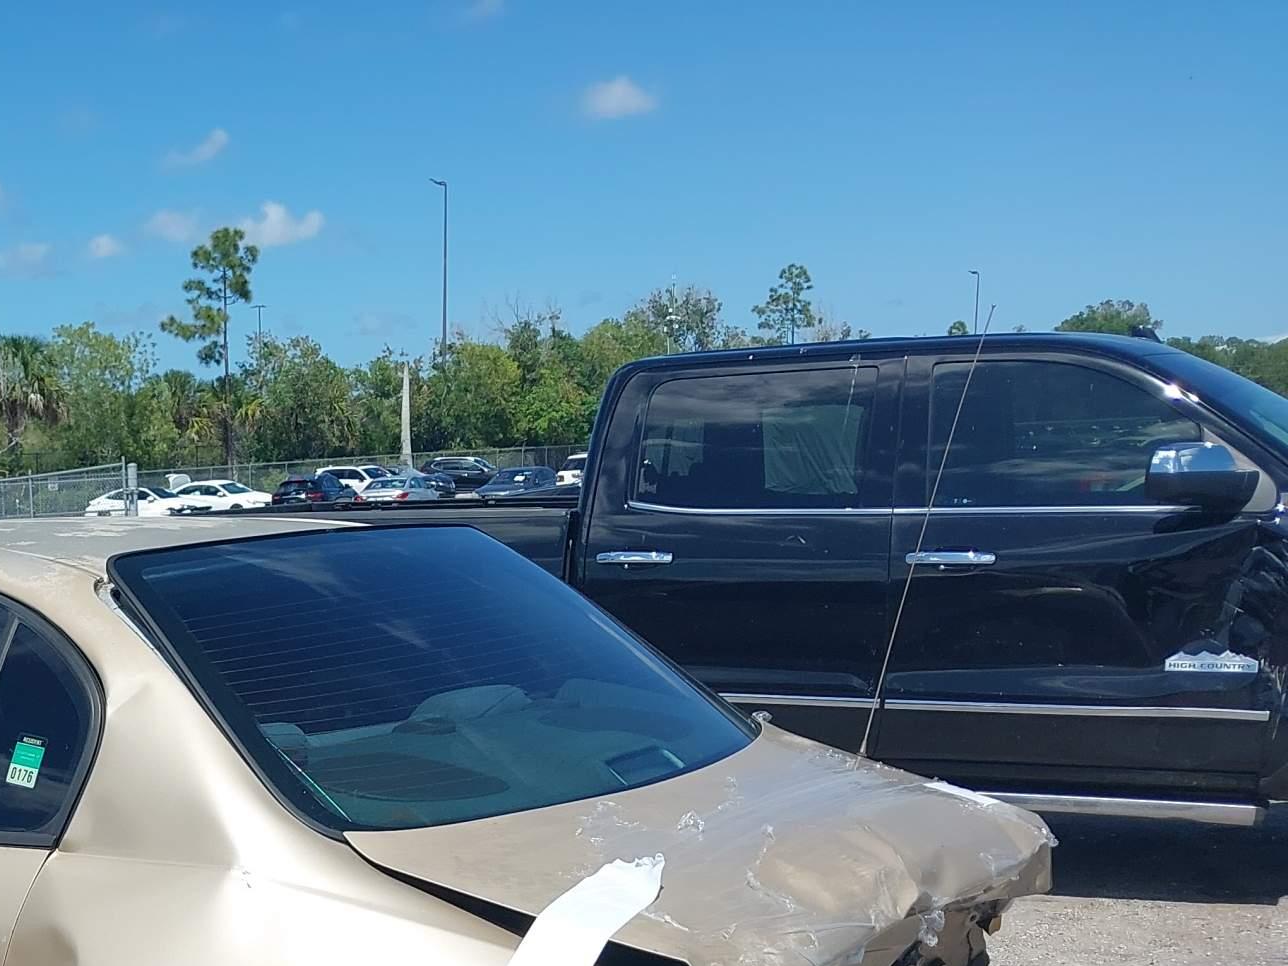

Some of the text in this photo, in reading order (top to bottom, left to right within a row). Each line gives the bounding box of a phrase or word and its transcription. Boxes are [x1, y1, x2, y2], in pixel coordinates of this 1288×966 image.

[1168, 662, 1252, 670] HIGH COUNTRY
[10, 766, 34, 784] 0176
